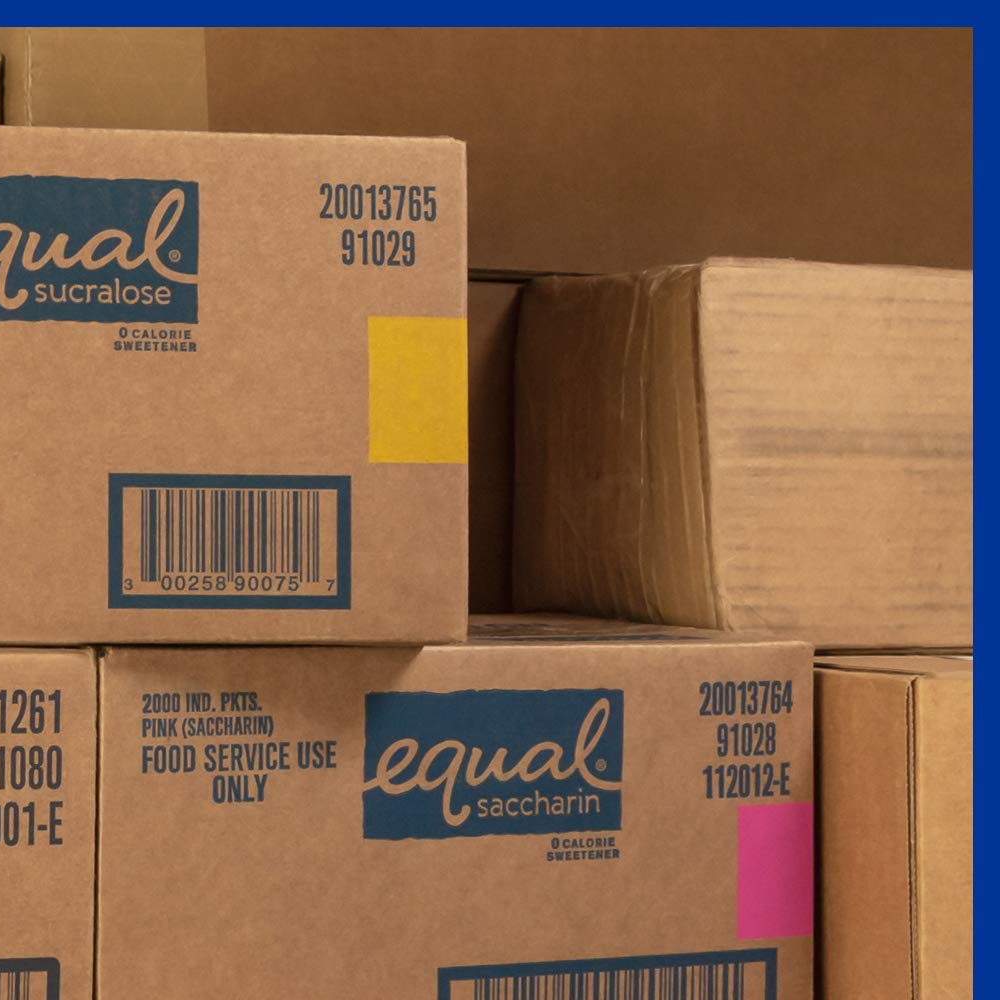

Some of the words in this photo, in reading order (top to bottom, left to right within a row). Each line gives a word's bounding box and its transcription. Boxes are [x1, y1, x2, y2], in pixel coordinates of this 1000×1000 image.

[319, 183, 437, 222] 20013765
[341, 229, 416, 267] 91029
[34, 278, 172, 305] sucralose
[113, 340, 197, 352] SWEETENER
[132, 328, 192, 341] CALORIE
[124, 578, 134, 591] 3
[160, 575, 227, 592] 00258
[234, 575, 300, 592] 90075
[326, 579, 335, 592] 7
[142, 693, 181, 714] 2000
[185, 692, 216, 712] IND.
[220, 691, 263, 712] PKTS.
[699, 680, 793, 716] 20013764
[141, 718, 178, 738] PINK
[181, 715, 274, 739] (SACCHARIN)
[717, 722, 776, 757] 91028
[142, 744, 197, 774] FOOD
[203, 742, 290, 772] SERVICE
[297, 740, 337, 769] USE
[212, 774, 268, 804] ONLY
[702, 762, 791, 799] 112012-E
[477, 787, 600, 818] saccharin
[546, 849, 620, 862] SWEETENER
[562, 837, 616, 849] CALORIE
